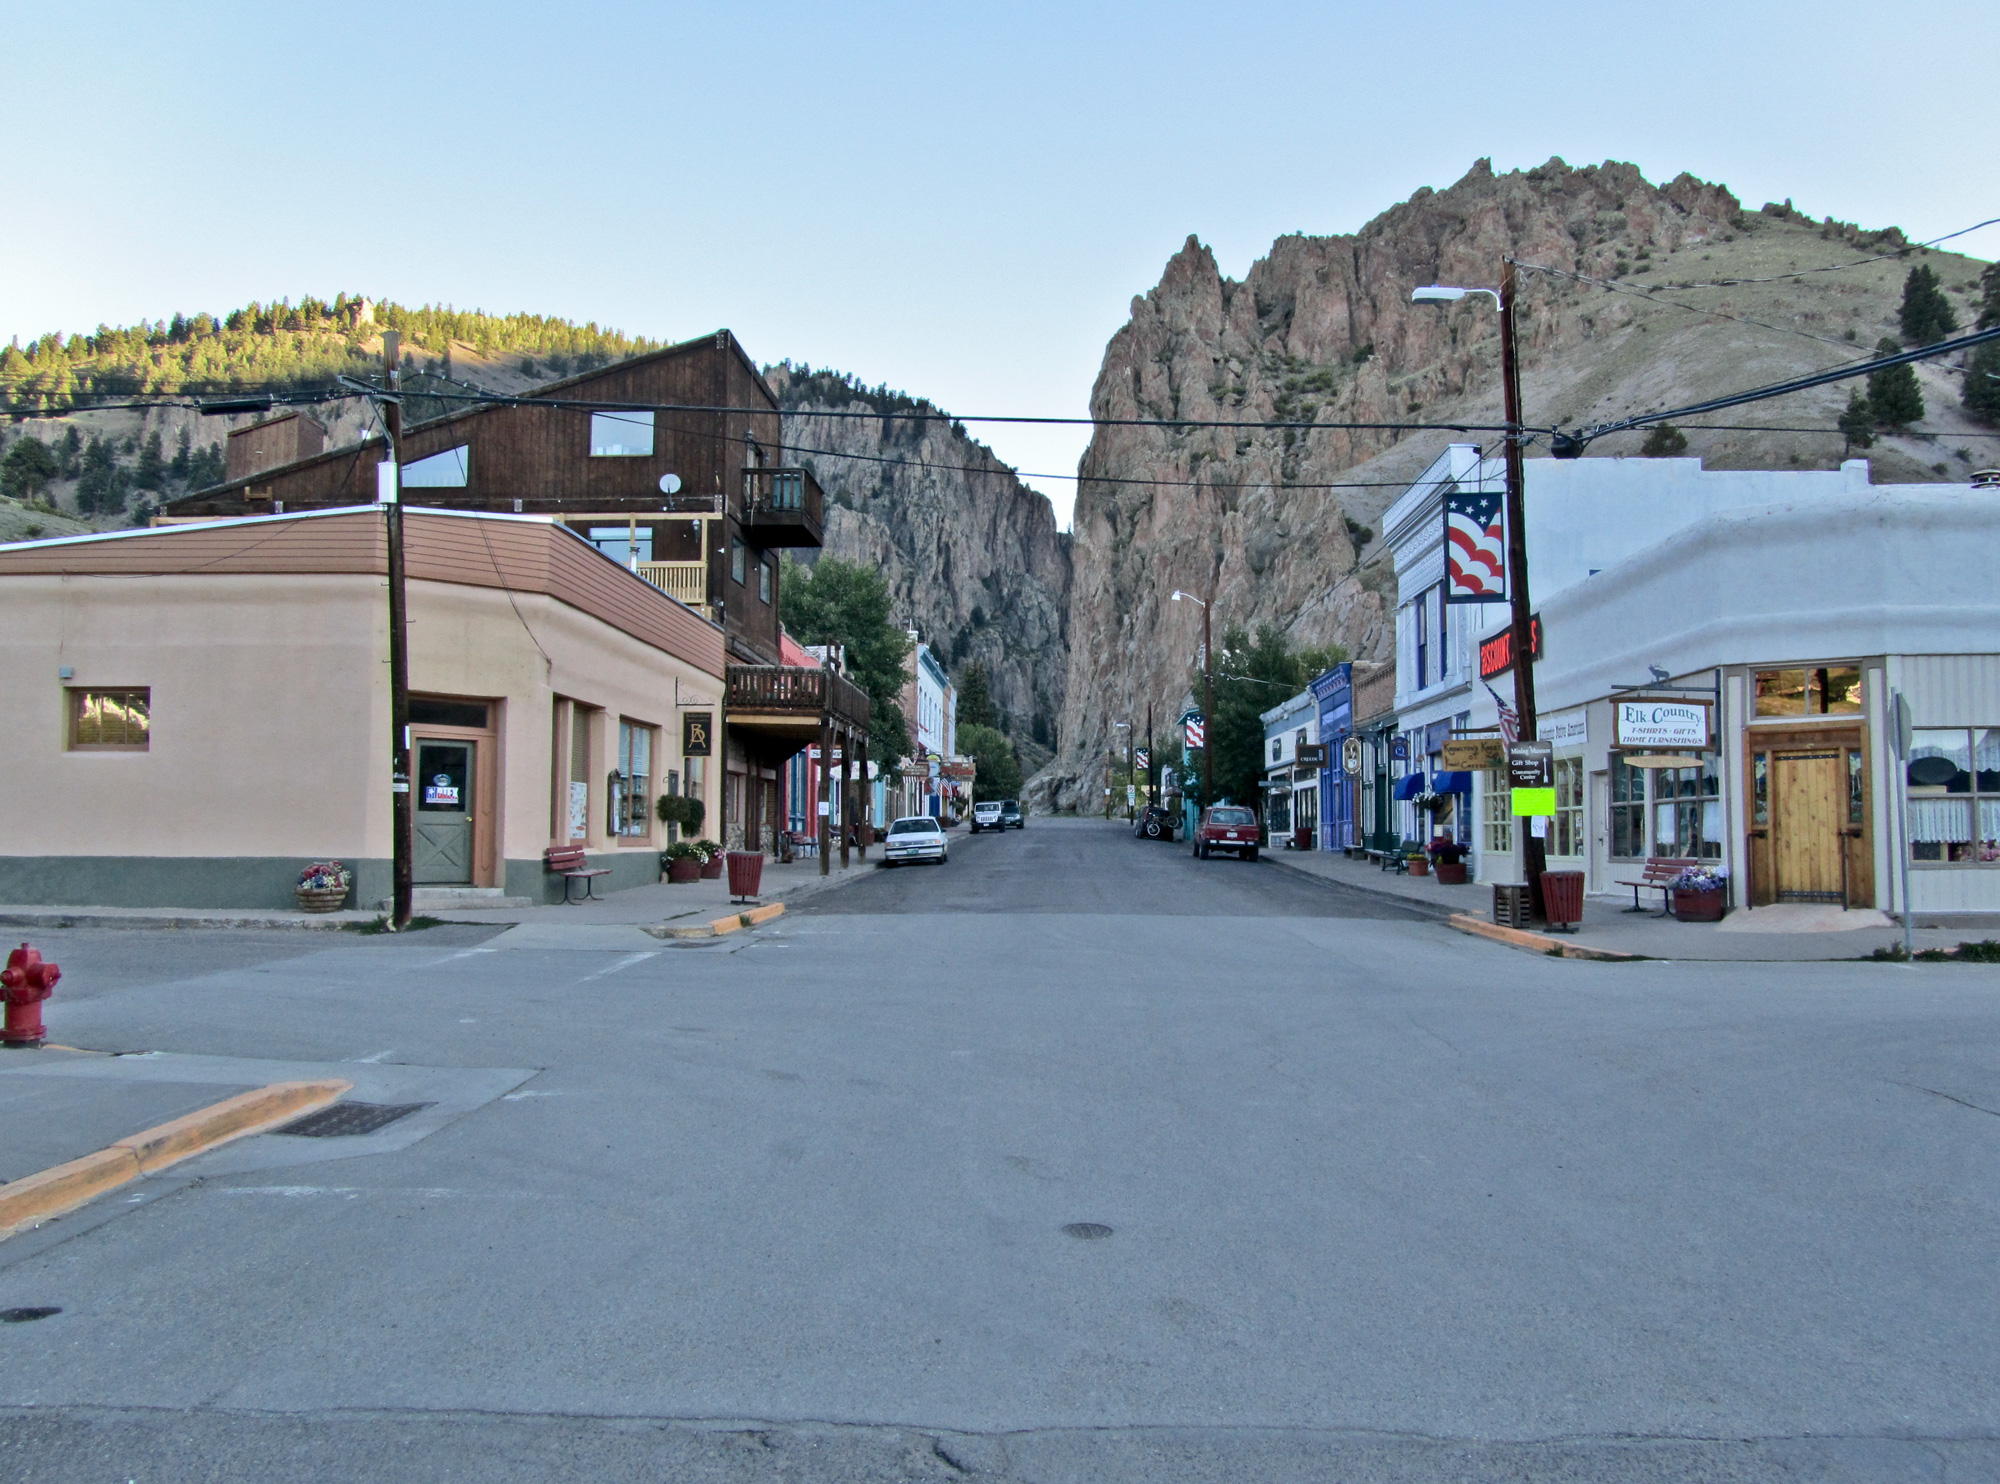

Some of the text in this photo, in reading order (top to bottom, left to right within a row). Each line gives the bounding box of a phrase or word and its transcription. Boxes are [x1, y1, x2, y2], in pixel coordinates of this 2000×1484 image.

[1625, 705, 1702, 727] Elk Country
[1631, 727, 1697, 735] T-SHIRTS GIFTS
[1647, 736, 1703, 745] FURNISHINGS
[1511, 748, 1529, 756] Mining
